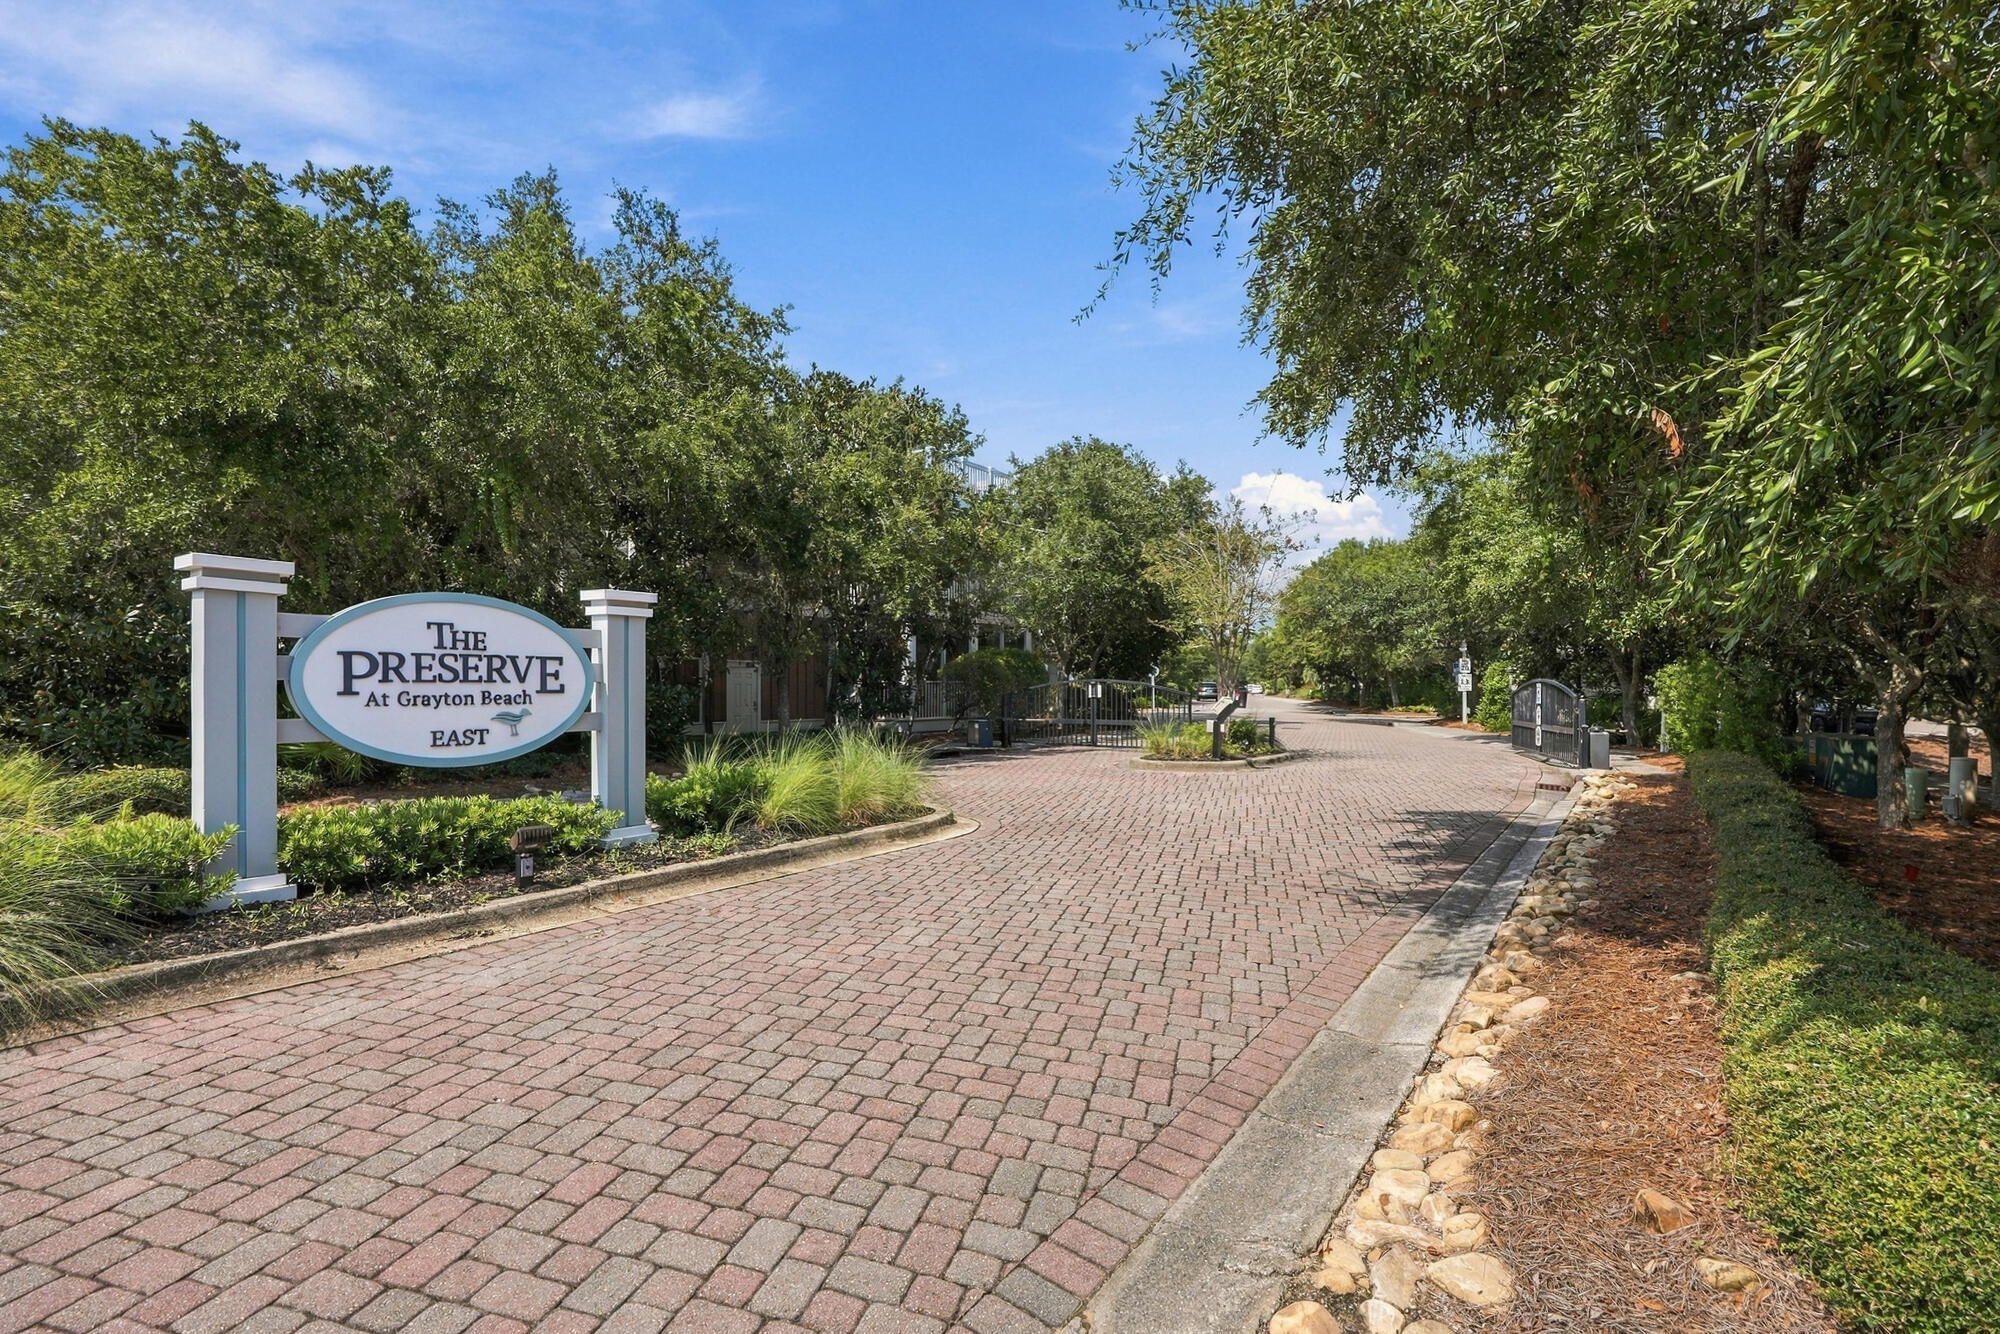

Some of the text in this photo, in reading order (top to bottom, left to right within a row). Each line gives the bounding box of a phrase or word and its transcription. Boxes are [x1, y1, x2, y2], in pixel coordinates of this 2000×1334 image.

[426, 621, 487, 651] THE
[337, 651, 565, 695] PRESERVE
[365, 690, 533, 710] At Grayton Beach
[430, 729, 489, 747] EAST
